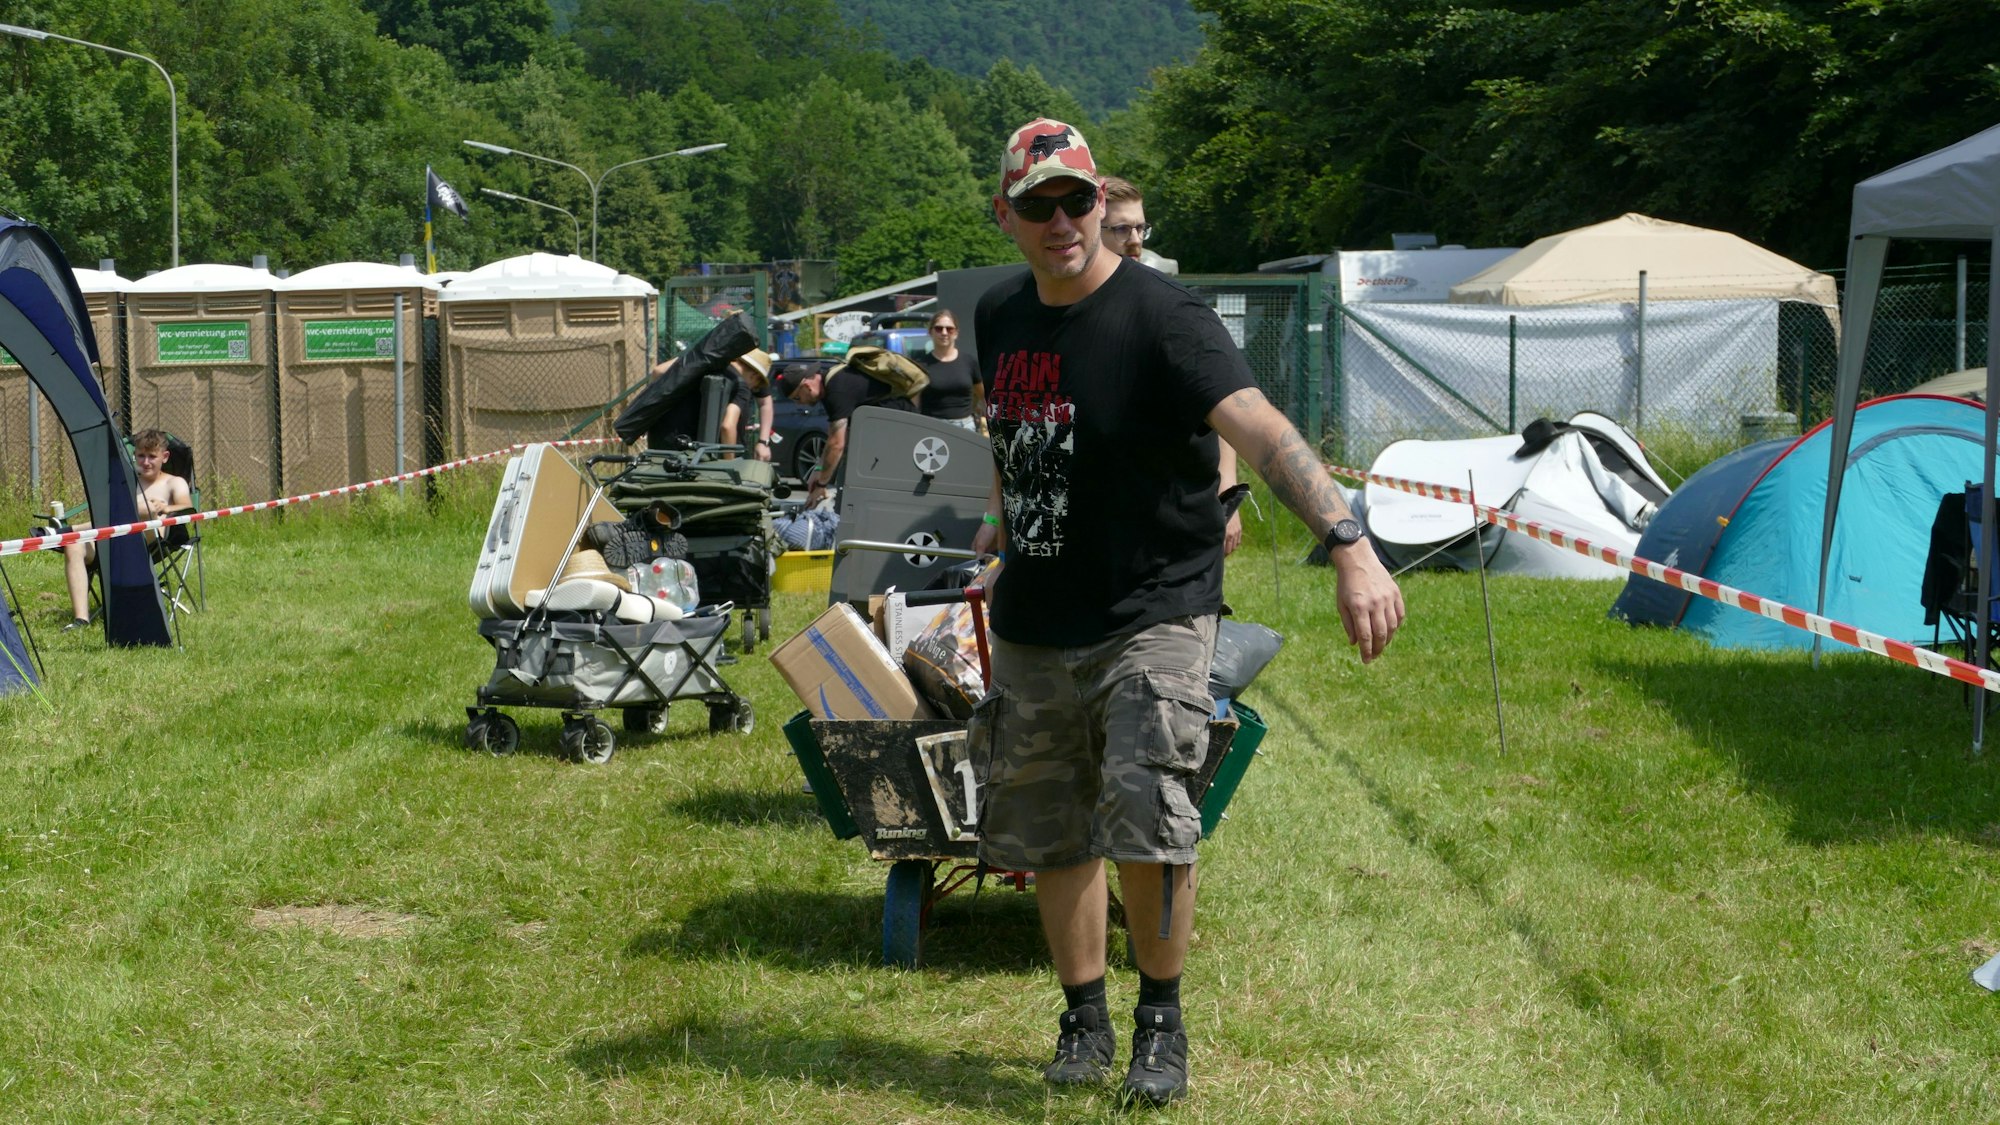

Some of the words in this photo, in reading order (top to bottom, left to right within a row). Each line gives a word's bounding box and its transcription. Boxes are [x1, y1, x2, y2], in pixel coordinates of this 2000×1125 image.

[160, 328, 246, 339] wc-vermietung.nrw
[306, 326, 393, 336] wc-vermietung.nrw
[993, 349, 1061, 391] VAIN
[895, 602, 903, 645] STAINLESS
[875, 826, 928, 840] Tuning
